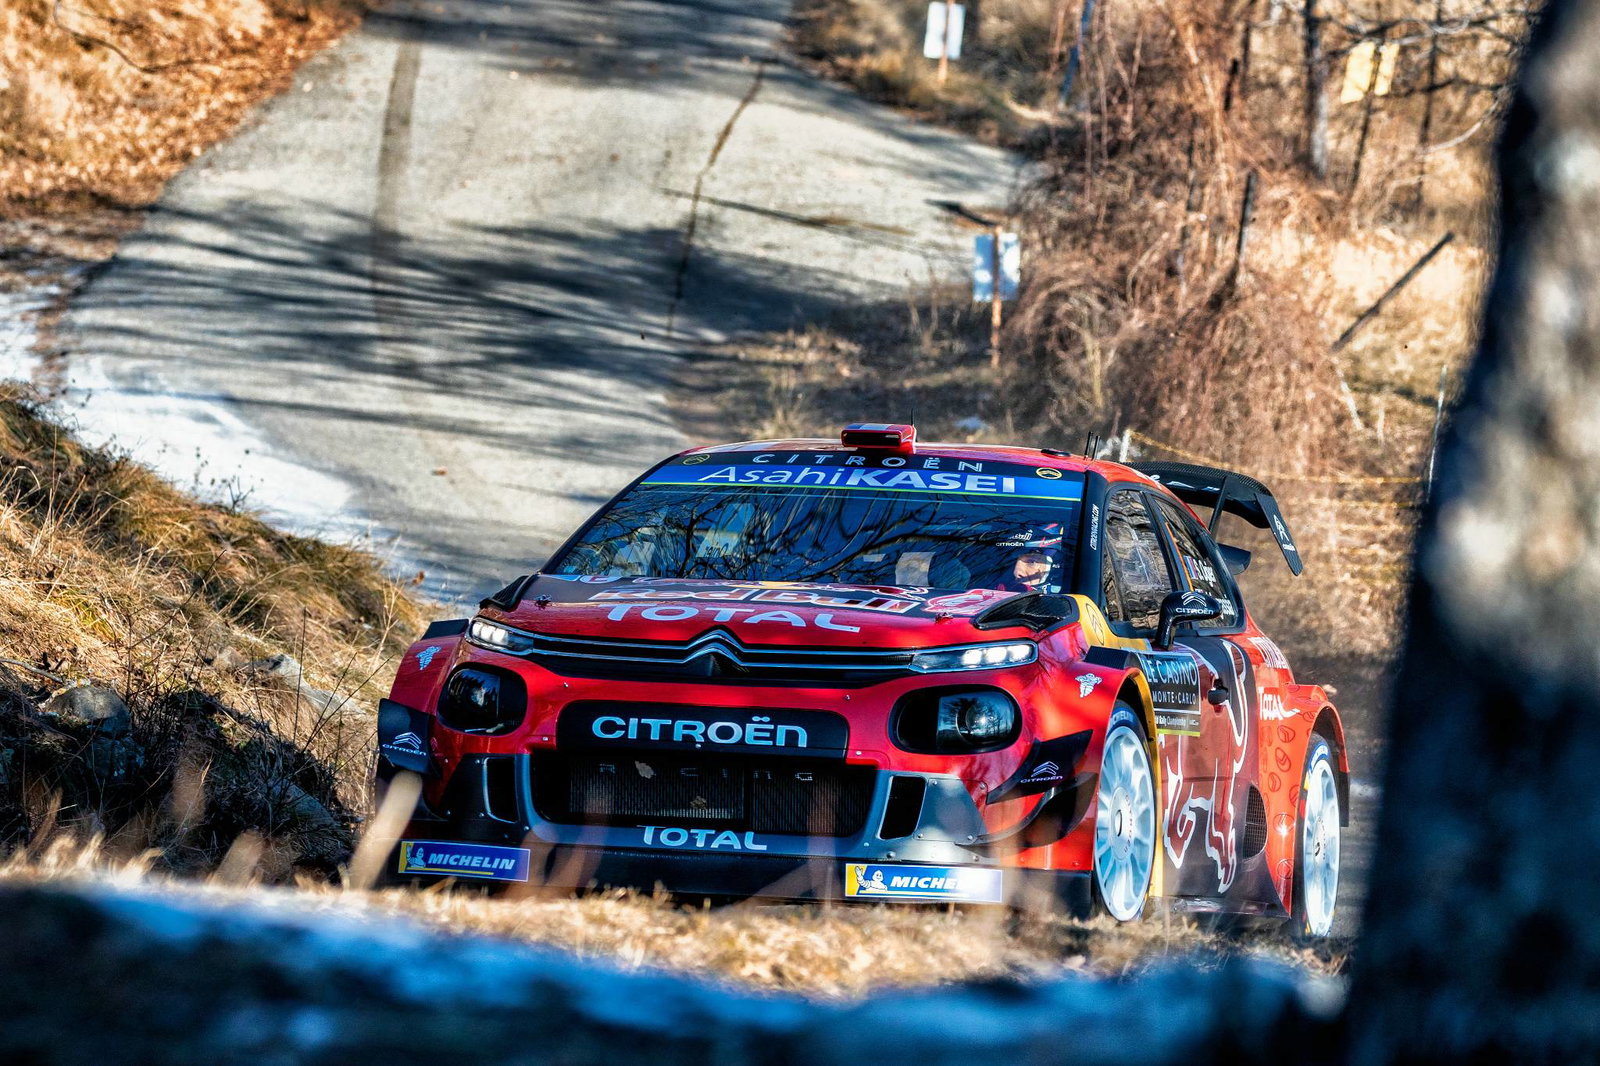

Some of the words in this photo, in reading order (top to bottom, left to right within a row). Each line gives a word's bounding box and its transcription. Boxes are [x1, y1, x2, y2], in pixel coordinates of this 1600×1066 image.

[752, 452, 983, 473] CITROËN
[587, 588, 757, 601] Red
[752, 589, 922, 614] Bull
[598, 602, 861, 634] TOTAL
[1156, 660, 1198, 686] CASINO
[1258, 686, 1300, 721] TOTAL
[591, 715, 808, 748] CITROËN
[637, 824, 768, 851] TOTAL
[427, 853, 516, 871] MICHELIN
[890, 875, 963, 891] MICHE
